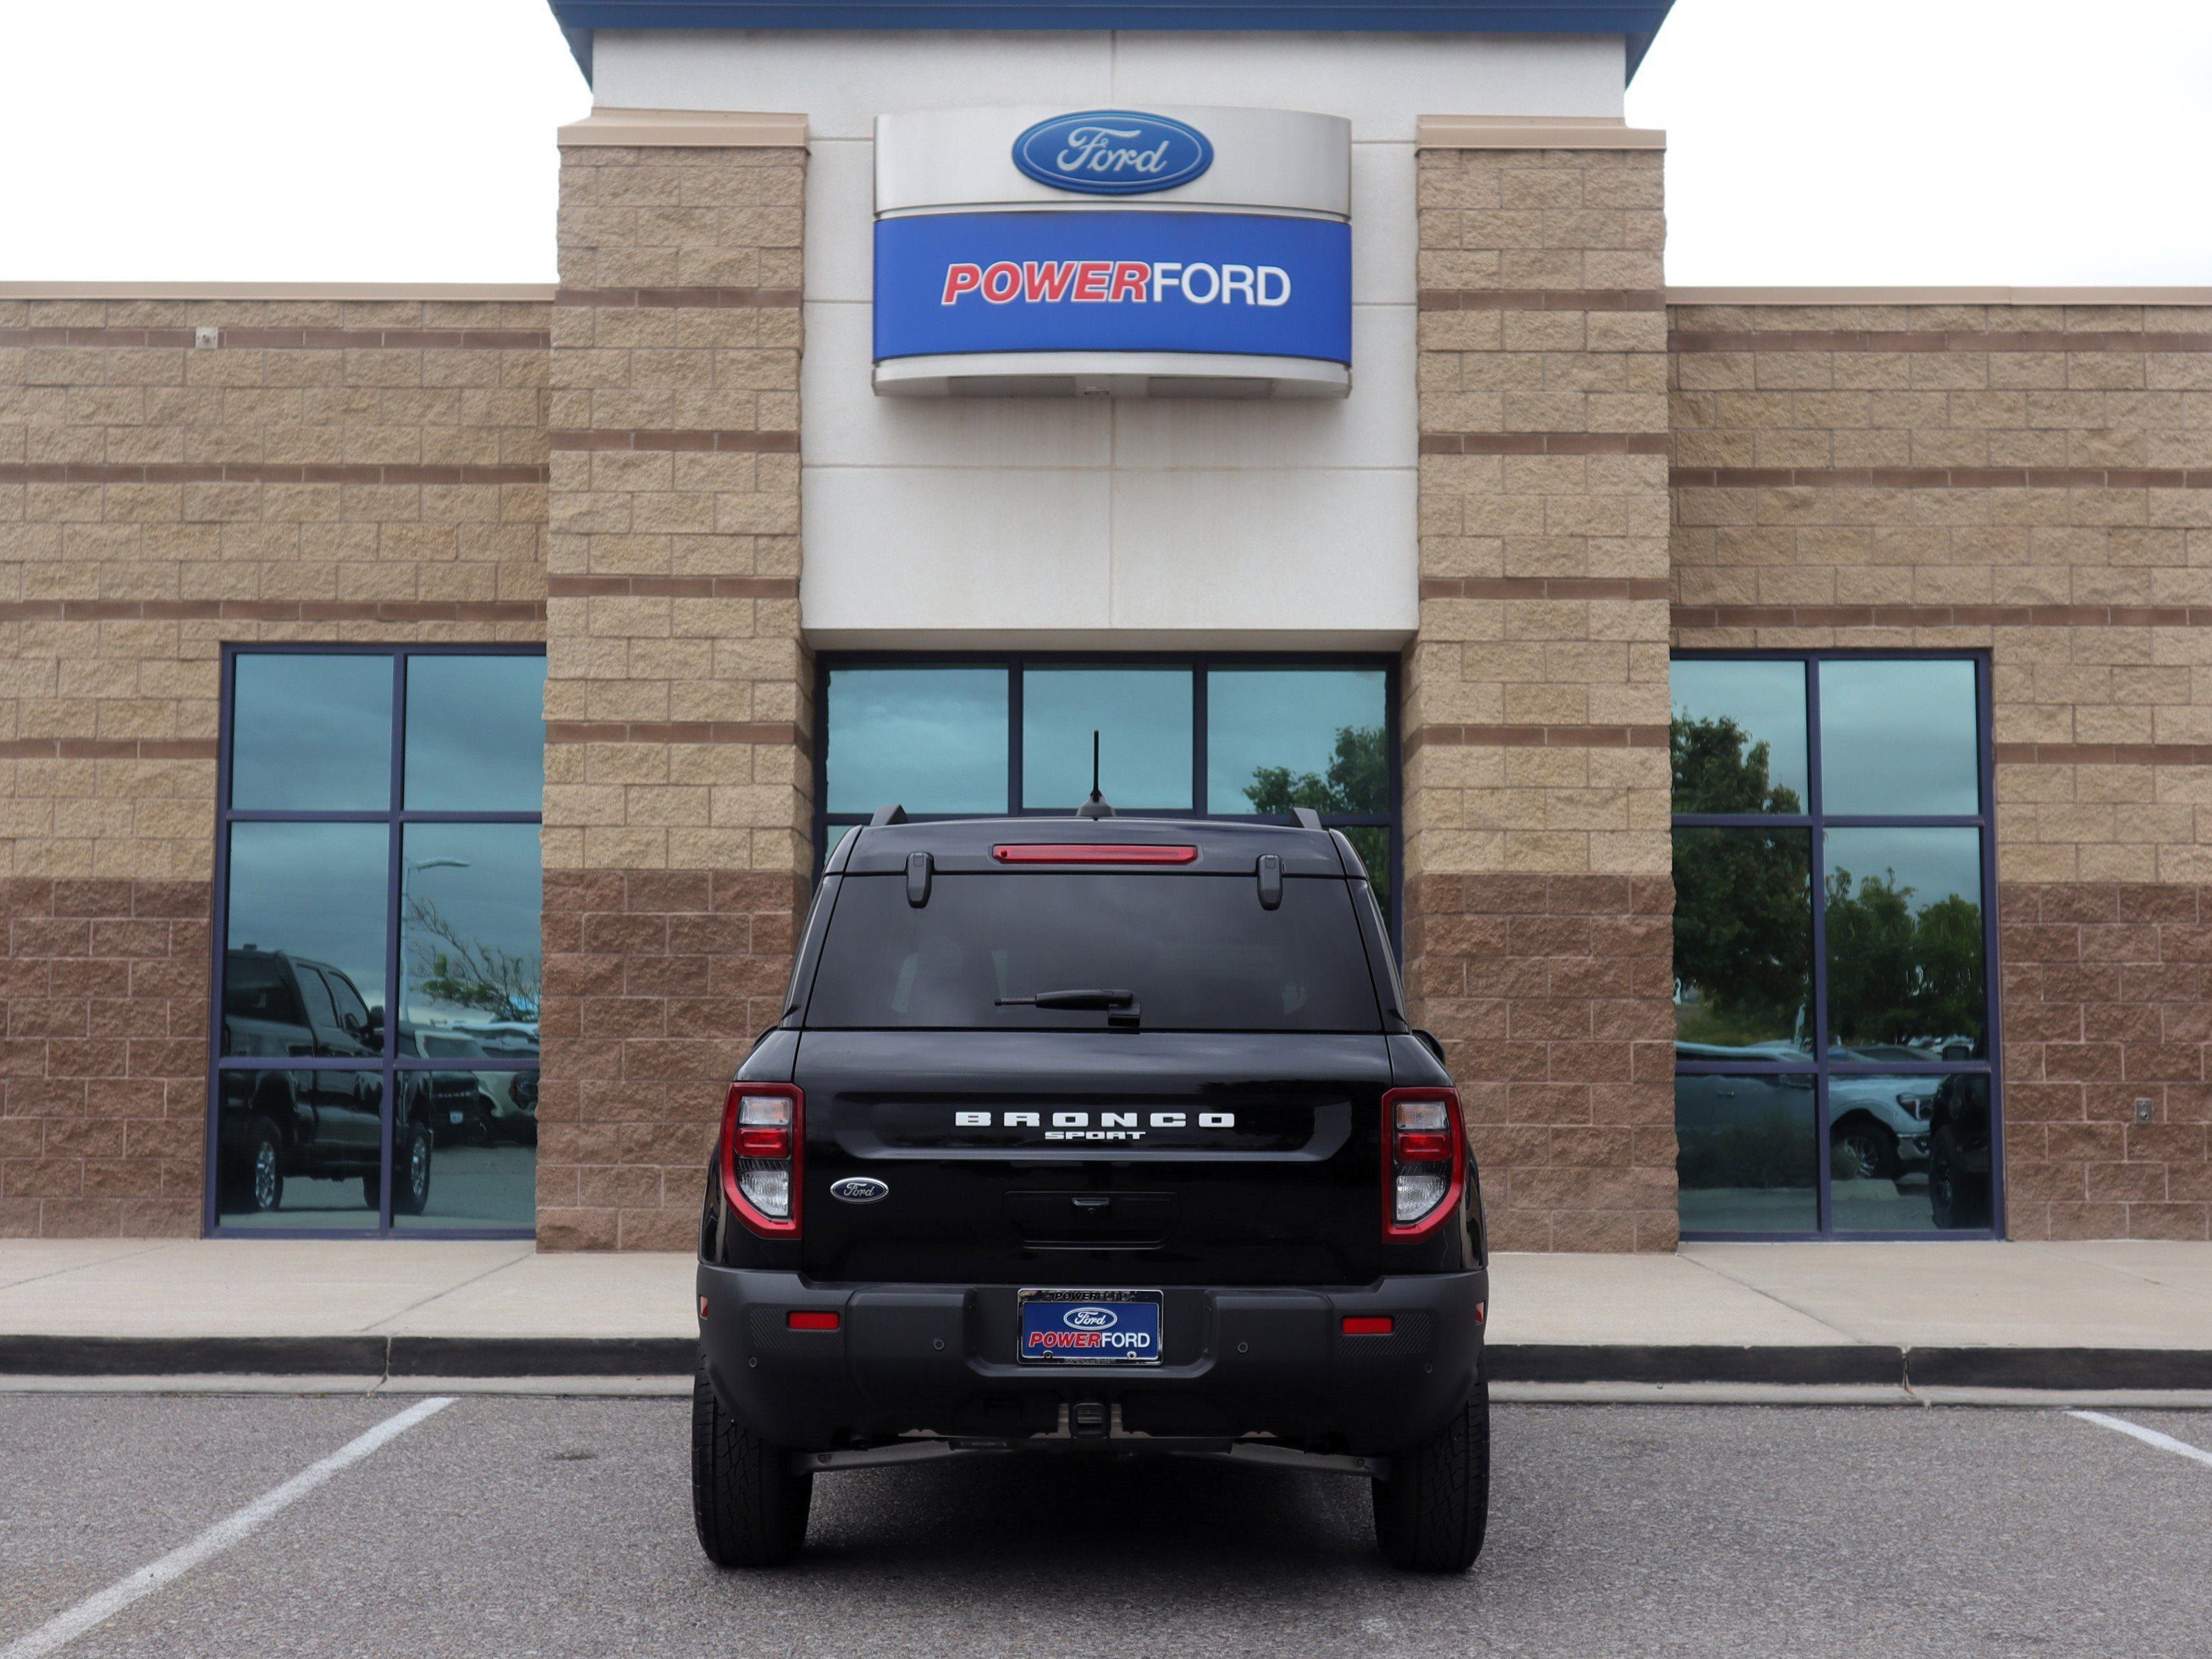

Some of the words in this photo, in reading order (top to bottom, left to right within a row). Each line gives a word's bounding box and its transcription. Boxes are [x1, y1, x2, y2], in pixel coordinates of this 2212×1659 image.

[1056, 126, 1169, 172] Ford
[956, 1112, 1235, 1127] BRONCO
[1045, 1131, 1146, 1140] SPORT
[843, 1183, 874, 1197] Ford
[1074, 1311, 1106, 1325] Ford
